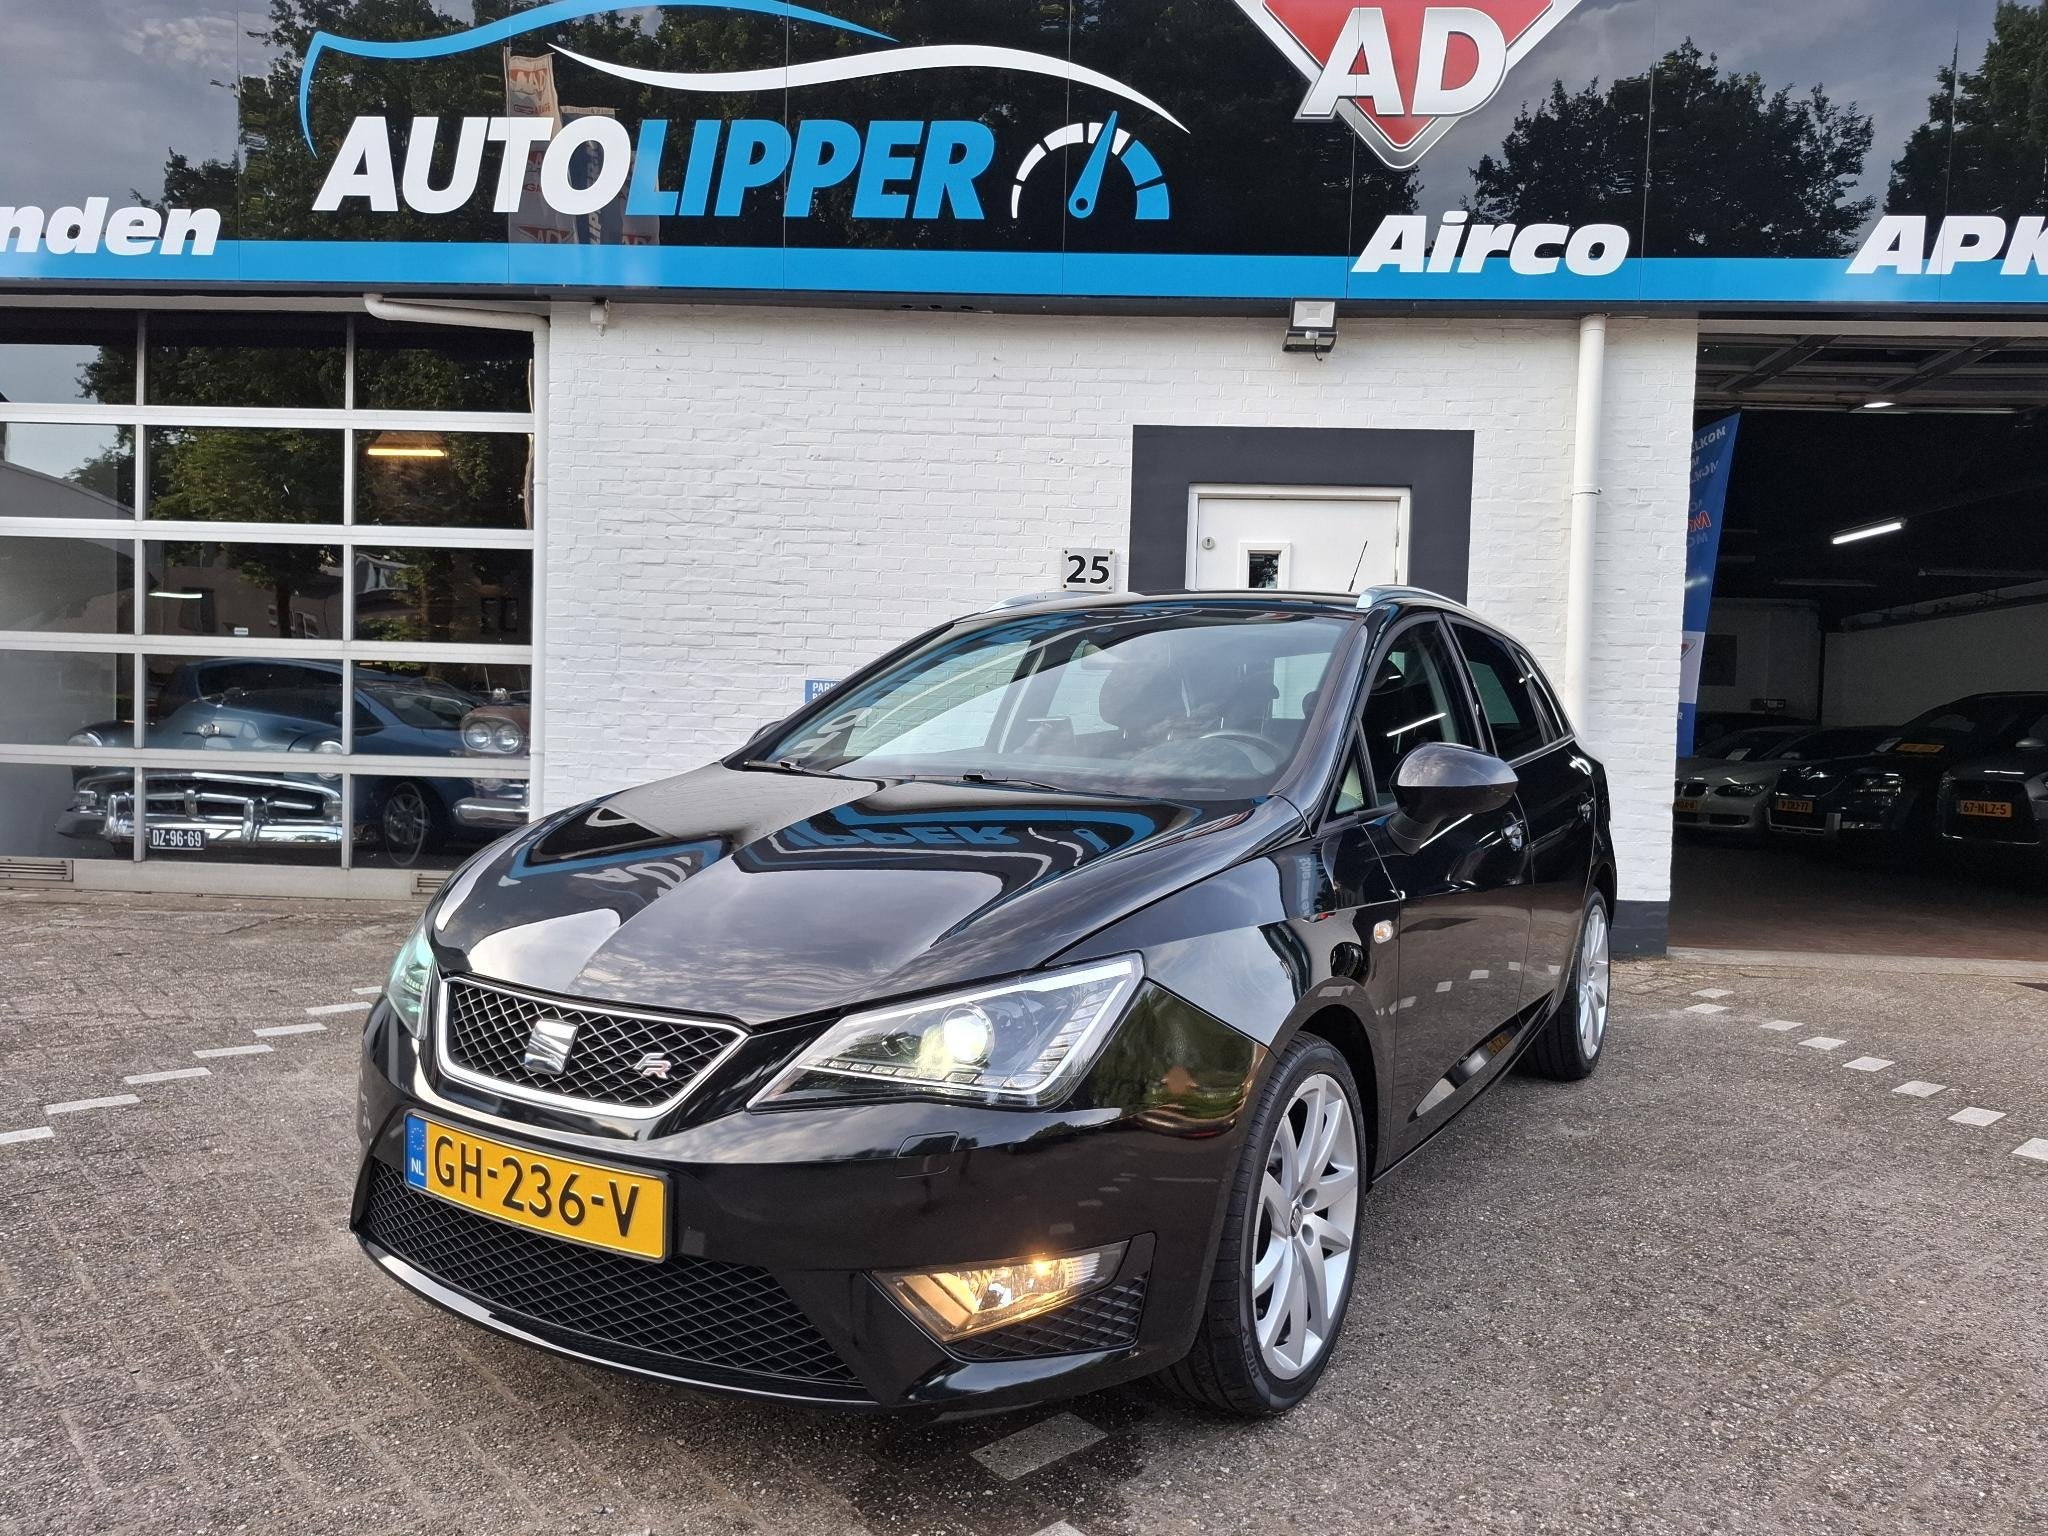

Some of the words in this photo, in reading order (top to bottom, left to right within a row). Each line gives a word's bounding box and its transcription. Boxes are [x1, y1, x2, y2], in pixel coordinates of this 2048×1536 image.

[1300, 7, 1507, 118] AD
[312, 115, 995, 220] AUTOLIPPER
[0, 197, 221, 256] nden
[1350, 211, 1630, 276] Airco
[1845, 215, 2048, 276] APK
[1067, 555, 1109, 584] 25
[153, 829, 201, 847] DZ-96-69
[411, 1158, 425, 1176] NL
[434, 1135, 640, 1237] GH-236-V
